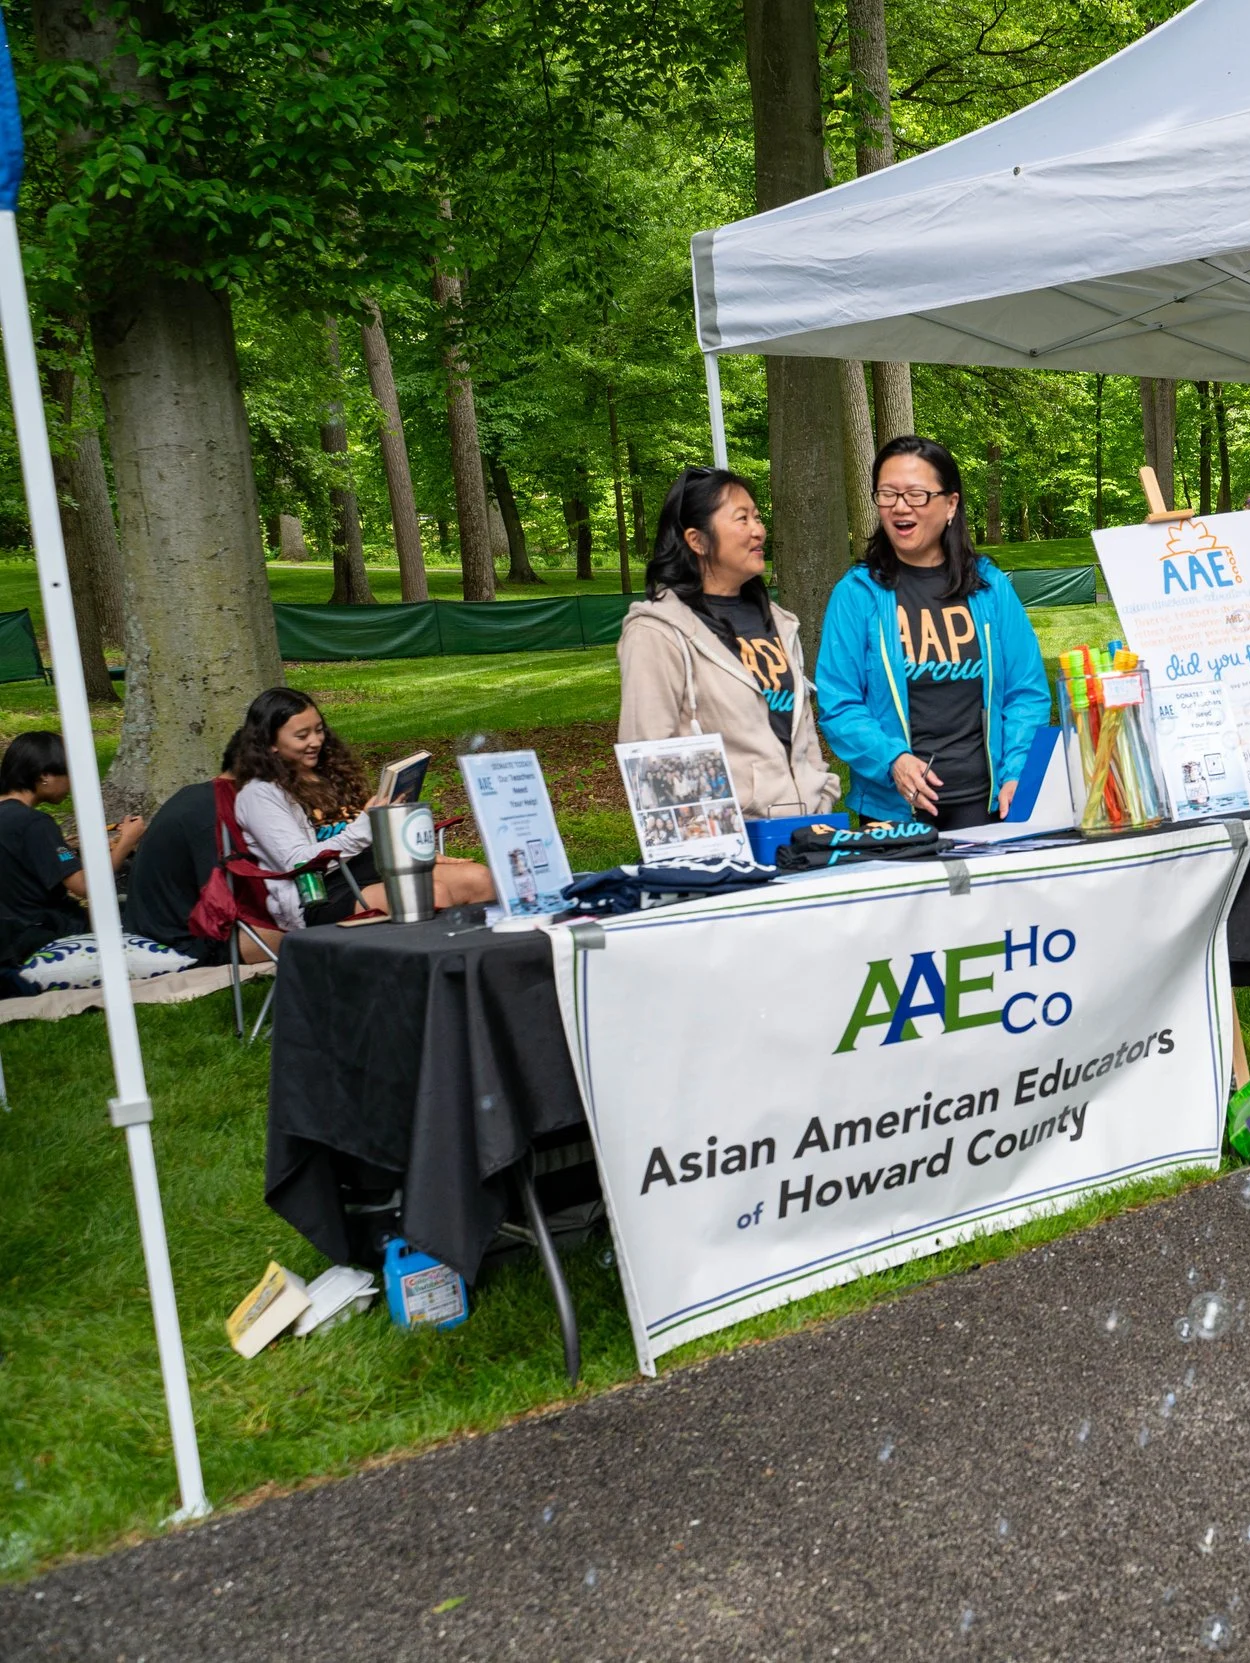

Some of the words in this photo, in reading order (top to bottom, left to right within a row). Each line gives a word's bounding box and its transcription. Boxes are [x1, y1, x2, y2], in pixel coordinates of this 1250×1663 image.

[1163, 551, 1234, 594] AAE
[1166, 652, 1202, 681] did
[1208, 653, 1244, 681] you
[416, 830, 434, 845] AAE
[833, 940, 1005, 1054] AAE
[641, 1133, 777, 1196] Asian
[794, 1088, 1000, 1159] American
[1014, 1028, 1176, 1105] Educators
[736, 1201, 765, 1231] of
[778, 1137, 953, 1219] Howard
[967, 1101, 1088, 1165] County
